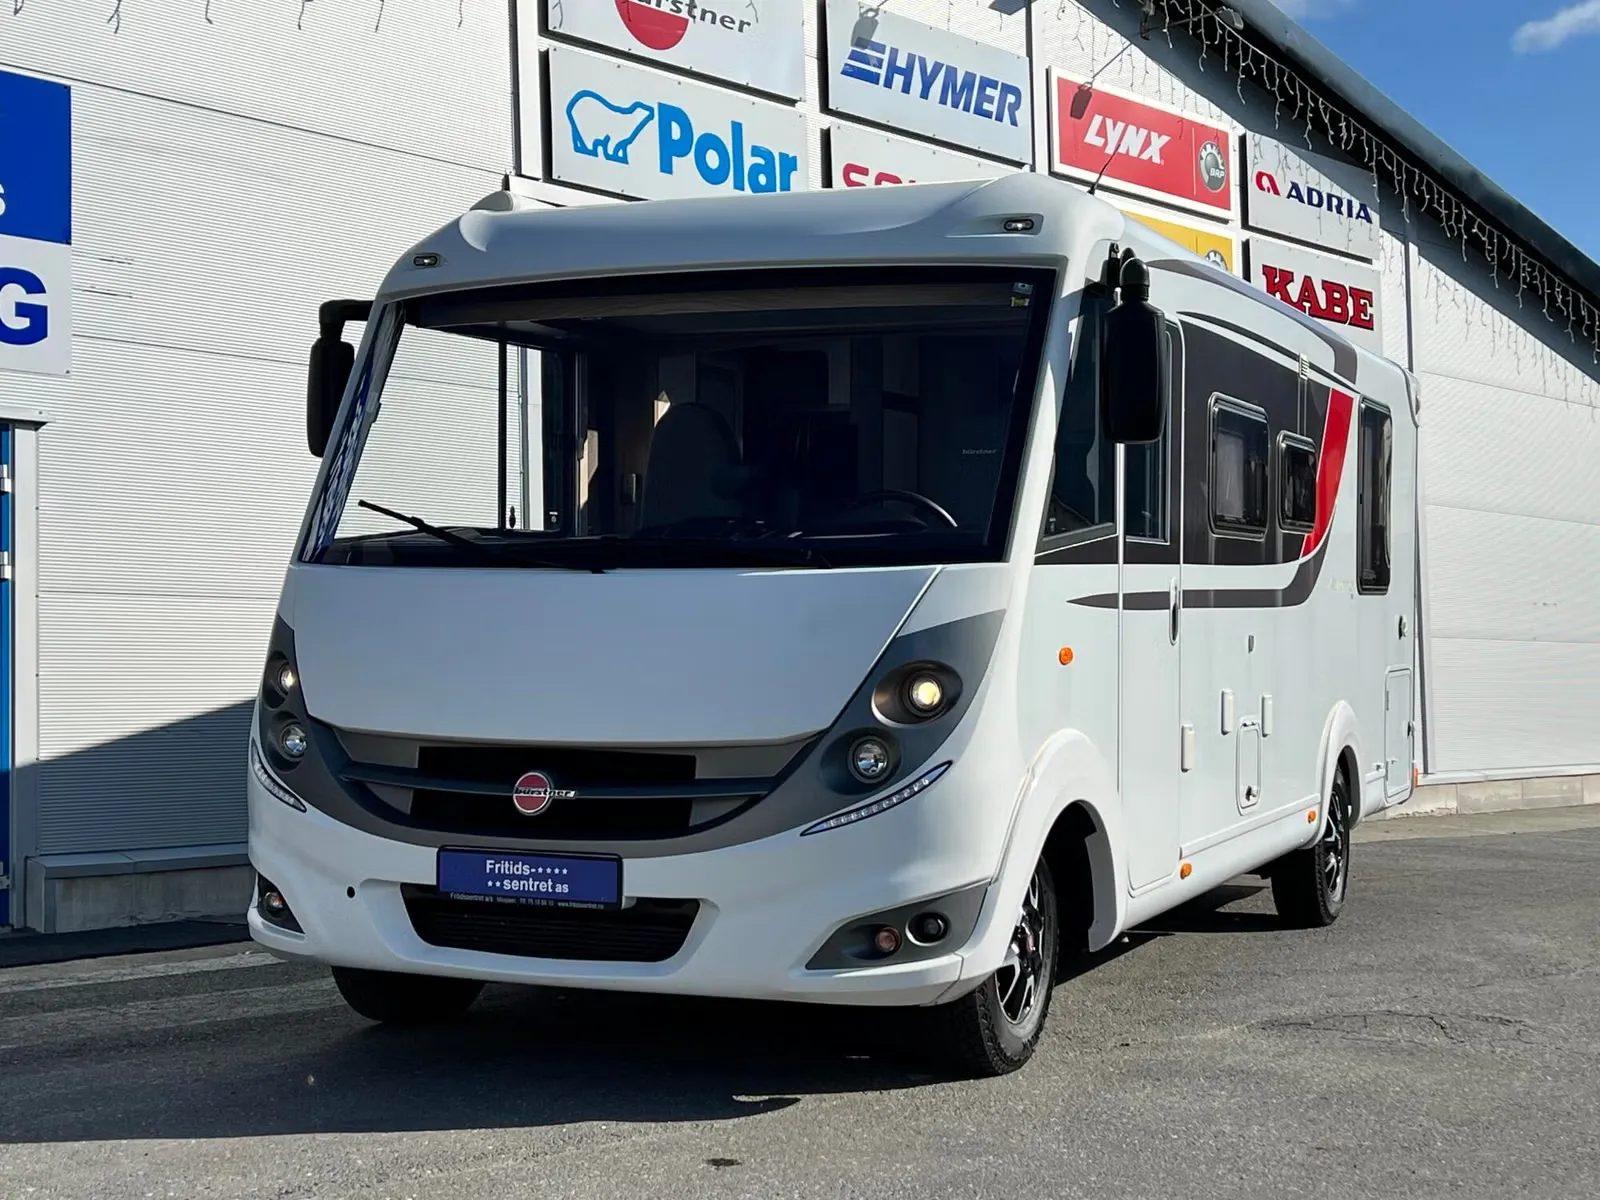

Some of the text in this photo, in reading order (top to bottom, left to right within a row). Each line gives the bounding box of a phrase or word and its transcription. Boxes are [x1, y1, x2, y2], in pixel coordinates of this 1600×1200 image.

[881, 52, 1022, 127] HYMER
[656, 102, 798, 194] Polar
[1083, 113, 1172, 165] LYNX
[1209, 167, 1226, 179] BRP
[1286, 180, 1373, 225] ADRIA
[1262, 263, 1375, 332] KABE
[485, 859, 536, 876] Fritids-
[502, 877, 569, 893] sentret as
